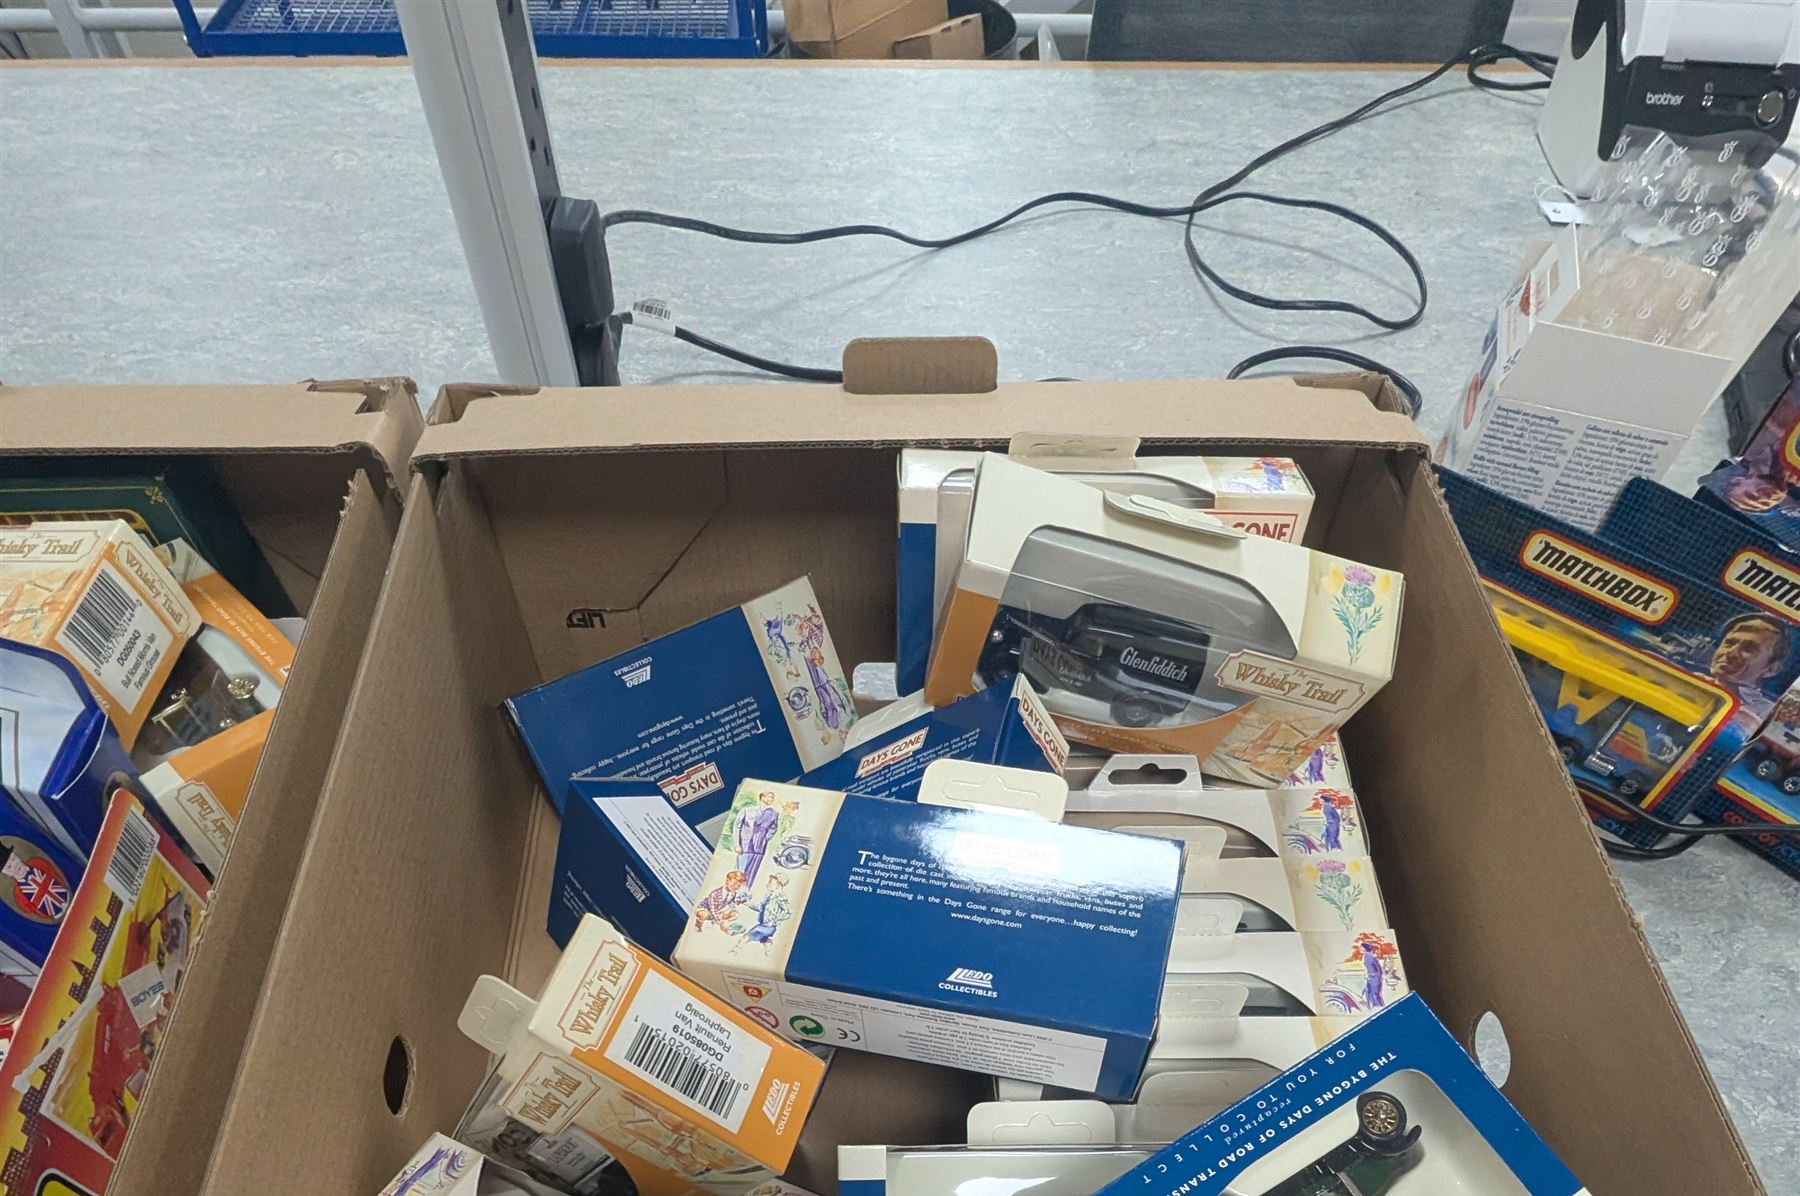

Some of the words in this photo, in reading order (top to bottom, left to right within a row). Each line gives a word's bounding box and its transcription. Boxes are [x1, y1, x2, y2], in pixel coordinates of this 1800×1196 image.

[1645, 91, 1684, 105] brother
[42, 537, 84, 556] Trail
[125, 553, 163, 610] Whisky
[160, 602, 185, 629] Trail
[612, 655, 653, 676] COLLECTIBLES
[1118, 645, 1190, 681] Glenfiddich
[1233, 661, 1301, 698] Whisky
[1301, 679, 1347, 706] Trail
[1019, 698, 1045, 734] DAYS
[1041, 731, 1067, 766] GONE
[858, 750, 887, 768] DAYS
[888, 732, 925, 755] GONE
[688, 771, 719, 793] DAYS
[856, 850, 879, 867] The
[881, 854, 907, 866] bygone
[909, 858, 925, 869] days
[927, 861, 937, 869] of
[867, 860, 902, 871] collection
[915, 867, 927, 875] die
[929, 870, 944, 878] cast
[849, 874, 863, 882] past
[865, 876, 879, 884] and
[880, 879, 909, 890] present.
[874, 869, 898, 880] they're
[928, 878, 948, 888] many
[949, 881, 981, 893] featuring
[1010, 890, 1035, 901] brands
[1037, 895, 1050, 903] and
[1052, 897, 1090, 910] household
[1092, 905, 1116, 914] names
[1117, 908, 1127, 916] of
[1128, 910, 1141, 918] the
[875, 887, 913, 900] something
[928, 895, 940, 903] the
[943, 898, 962, 908] Days
[966, 901, 987, 911] Gone
[990, 907, 1011, 916] range
[1015, 909, 1025, 917] for
[1098, 923, 1137, 937] collecting!
[1104, 898, 1125, 907] buses
[949, 911, 1022, 930] www.daysgone.com
[937, 981, 998, 998] COLLECTIBLES
[945, 965, 995, 988] LLEDO
[129, 980, 165, 1006] BOYES
[569, 981, 617, 1040] Whisky
[597, 951, 627, 989] Trail
[673, 1010, 694, 1028] Van
[683, 1002, 731, 1039] Laphroaig
[652, 1027, 691, 1056] 02015
[671, 1023, 724, 1061] DG085019
[693, 1023, 732, 1053] Renault
[694, 1052, 731, 1081] 80577
[1323, 1041, 1355, 1066] FOR
[1368, 1050, 1396, 1071] THE
[540, 1063, 582, 1099] Trail
[741, 1082, 750, 1091] 0
[1284, 1066, 1318, 1091] YOU
[1313, 1068, 1368, 1107] BYGONE
[517, 1084, 569, 1134] Whisky
[774, 1080, 801, 1135] COLLECTIBLES
[1254, 1092, 1277, 1110] TO
[1222, 1096, 1293, 1146] recaptured
[1277, 1103, 1312, 1130] DAYS
[1141, 1111, 1246, 1184] COLLECT
[1256, 1126, 1276, 1143] OF
[1216, 1140, 1254, 1169] ROAD
